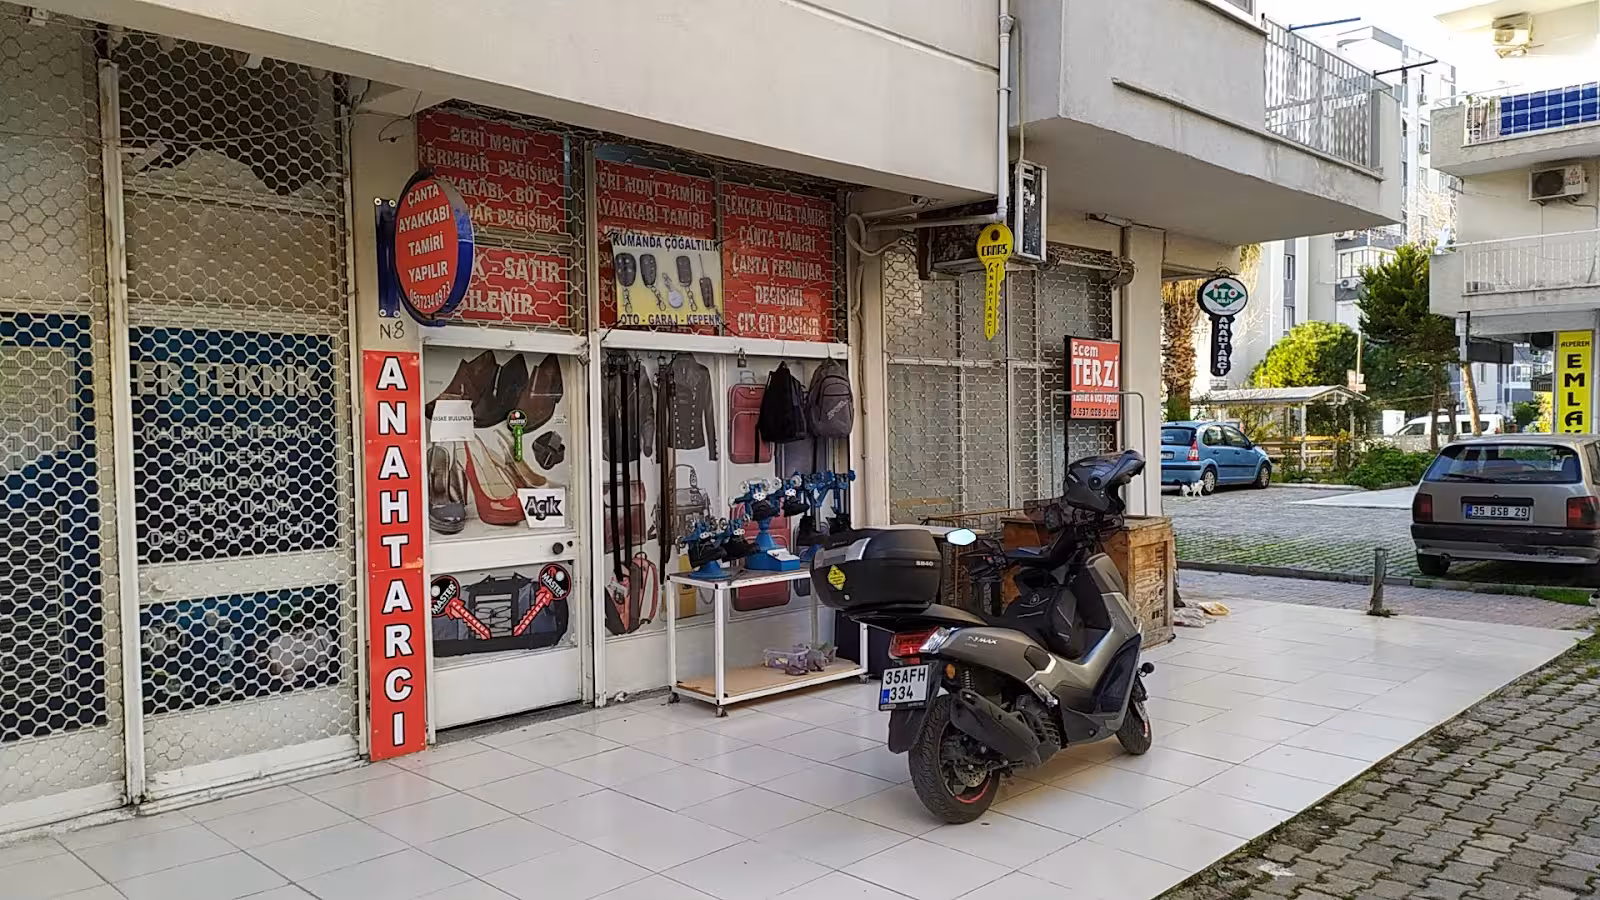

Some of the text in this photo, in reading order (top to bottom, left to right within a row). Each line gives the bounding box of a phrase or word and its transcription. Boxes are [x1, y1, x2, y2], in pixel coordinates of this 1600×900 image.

[490, 134, 528, 155] MONT
[407, 184, 440, 208] ÇANTA
[516, 186, 541, 205] BOT
[399, 205, 450, 233] AYAKKABI
[408, 231, 444, 256] TAMİRİ
[612, 231, 662, 248] KUMANDA
[408, 260, 448, 284] YAPILIR
[504, 257, 560, 283] SATIR
[987, 268, 995, 335] ANAHTARCI
[620, 314, 640, 325] OTO
[648, 314, 678, 325] GARAJ
[1072, 341, 1098, 357] Ecem
[1216, 316, 1229, 375] ANAHTARCI
[136, 355, 318, 396] ER TEKNİK
[1072, 355, 1119, 388] TERZİ
[1563, 353, 1585, 433] EMLA
[525, 497, 559, 519] Açık
[1473, 504, 1527, 517] 35 BSB 29
[377, 355, 414, 747] ANAHTARCI
[541, 572, 565, 598] MASTER
[431, 583, 457, 614] MASTER
[890, 685, 914, 701] 334
